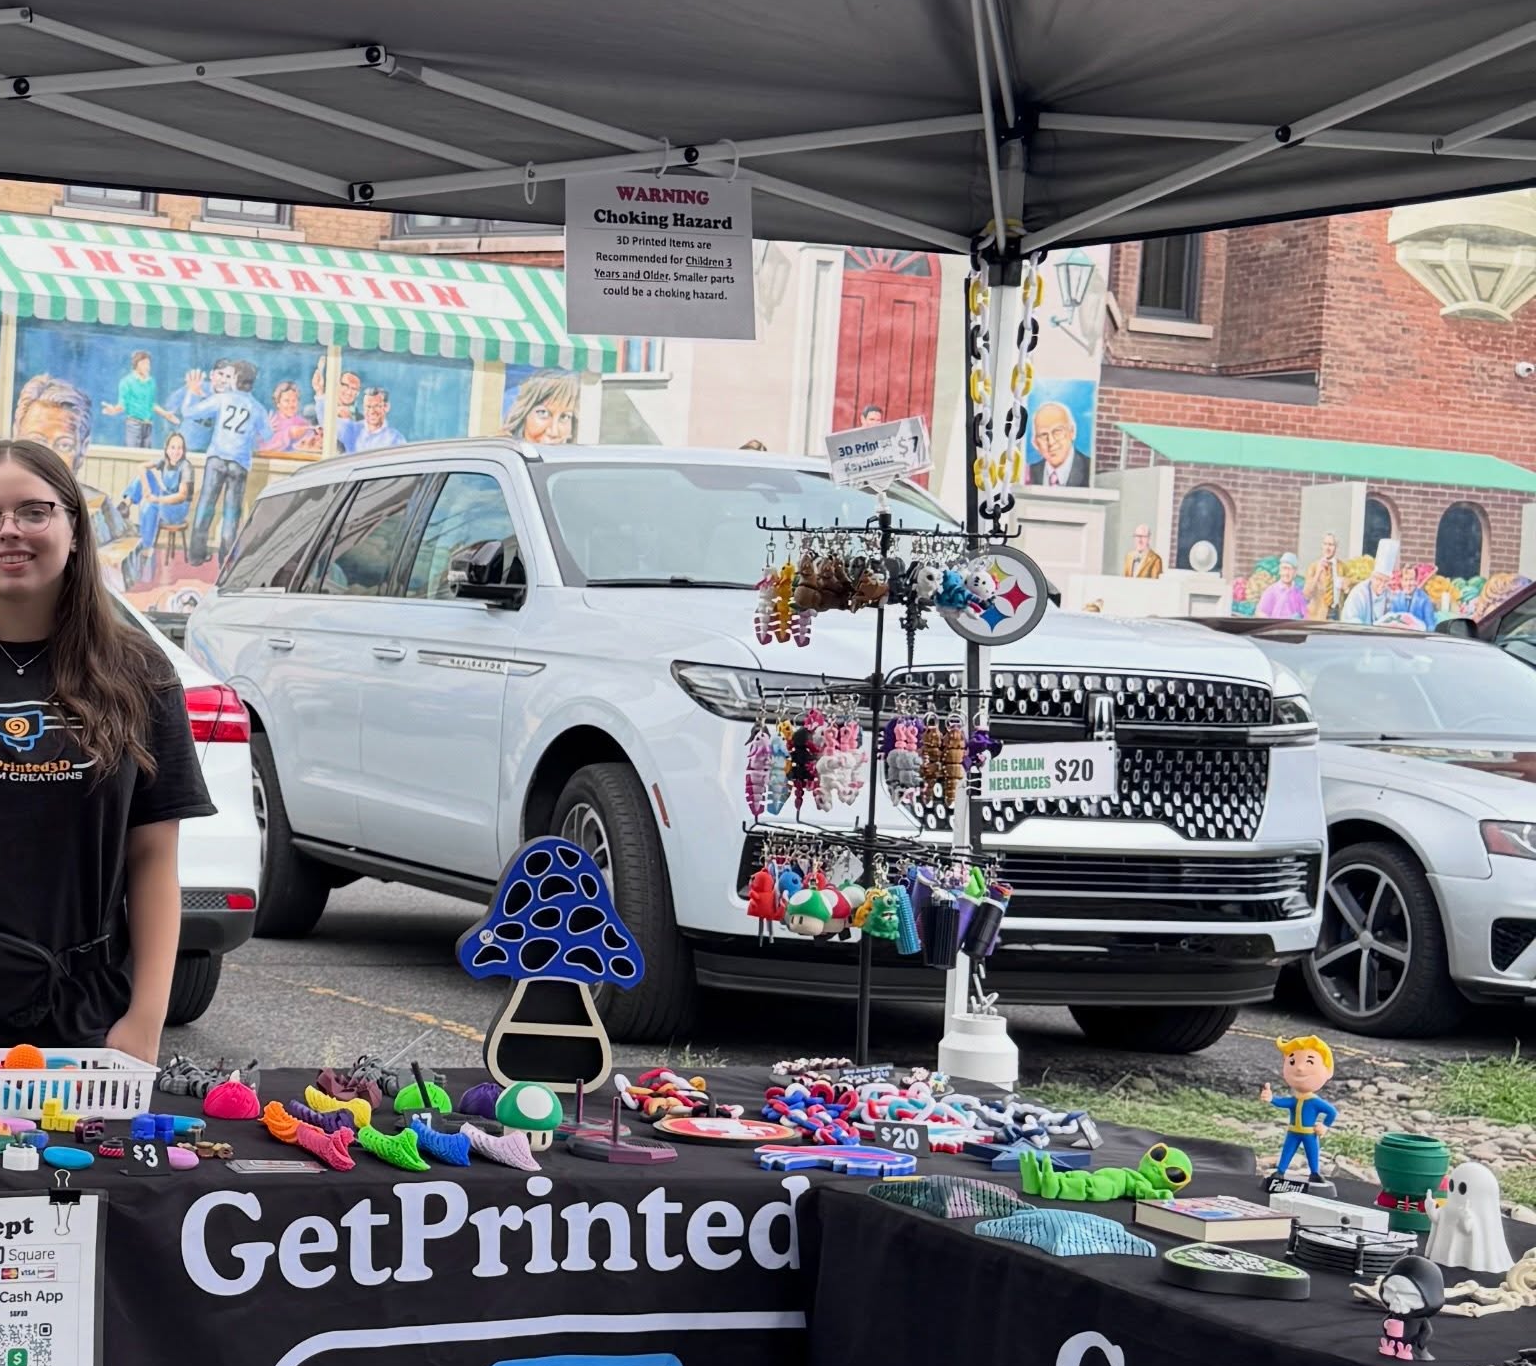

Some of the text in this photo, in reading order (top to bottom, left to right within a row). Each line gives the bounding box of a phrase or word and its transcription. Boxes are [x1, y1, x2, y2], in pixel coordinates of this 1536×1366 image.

[616, 186, 709, 205] WARNING
[593, 208, 733, 230] Choking Hazard
[616, 236, 712, 250] 3D Printed Items are
[596, 252, 733, 267] Recommended for Children 3
[49, 242, 470, 310] INSPIRATION
[594, 268, 735, 285] Years and Older. Smaller parts
[603, 286, 630, 297] could
[632, 287, 644, 297] be
[654, 288, 691, 300] choking
[692, 289, 728, 300] hazard.
[222, 404, 251, 435] 22
[838, 446, 853, 457] 3D
[898, 435, 919, 457] $7
[9, 770, 83, 782] CREATIONS
[988, 757, 1094, 784] BIG CHAIN $20
[988, 775, 1051, 791] NECKLACES
[880, 1127, 920, 1150] $20
[133, 1144, 158, 1168] $3
[181, 1176, 811, 1296] GetPrinted
[8, 1248, 55, 1264] Square
[0, 1290, 32, 1303] Cash
[36, 1290, 64, 1304] App
